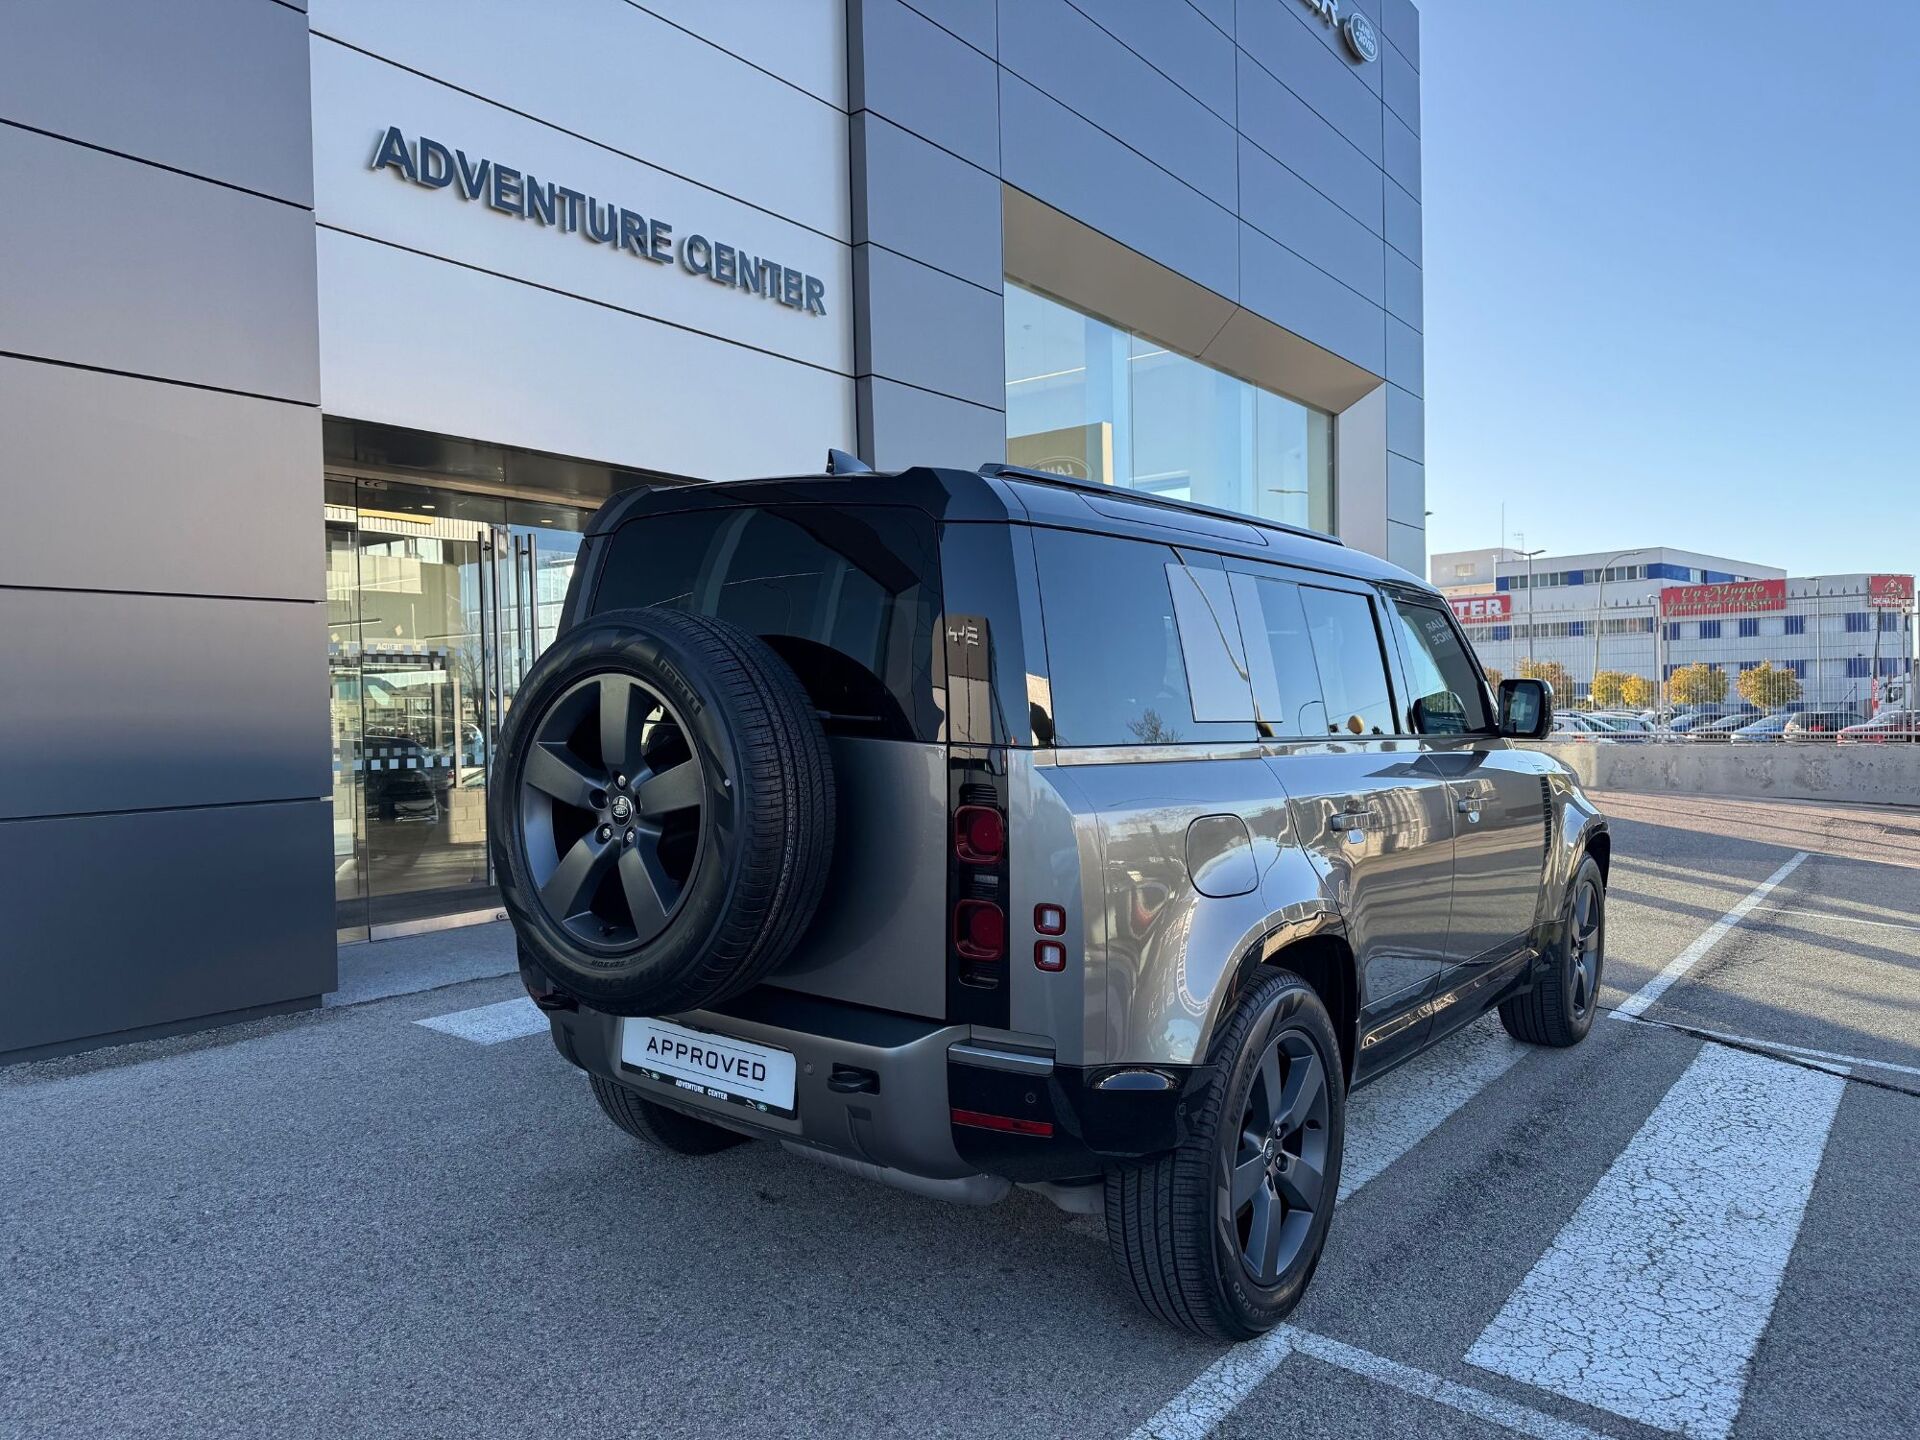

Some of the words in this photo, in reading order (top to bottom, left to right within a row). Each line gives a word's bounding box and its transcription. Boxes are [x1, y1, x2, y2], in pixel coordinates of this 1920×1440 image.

[1357, 19, 1375, 41] LAND
[1356, 31, 1375, 54] ROVER
[373, 126, 674, 264] ADVENTURE
[683, 234, 827, 316] CENTER
[1450, 599, 1502, 619] TER
[646, 1036, 766, 1082] APPROVED
[675, 1079, 704, 1094] ADVENTURE
[707, 1088, 728, 1101] CENTER
